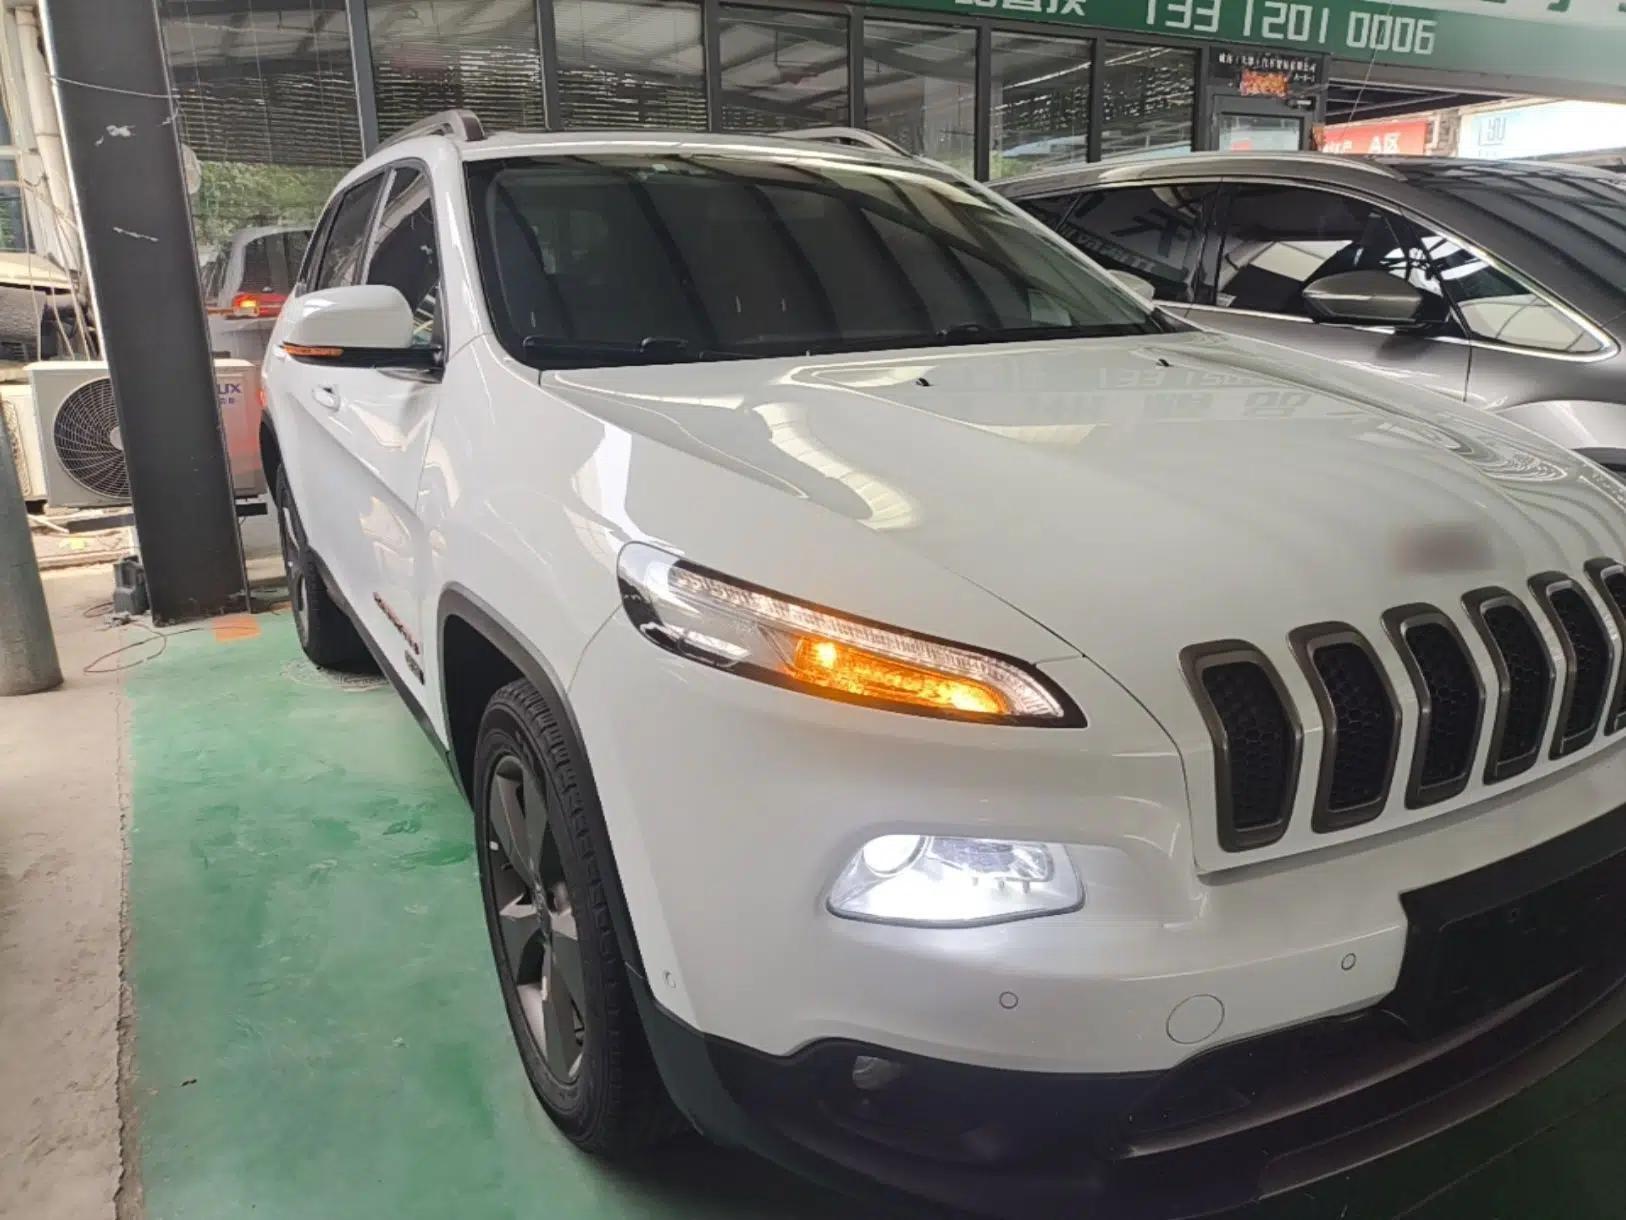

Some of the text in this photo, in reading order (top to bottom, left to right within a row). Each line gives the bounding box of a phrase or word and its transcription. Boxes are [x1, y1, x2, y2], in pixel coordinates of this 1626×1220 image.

[1146, 0, 1438, 55] 133 1201 0006
[216, 383, 241, 394] UX
